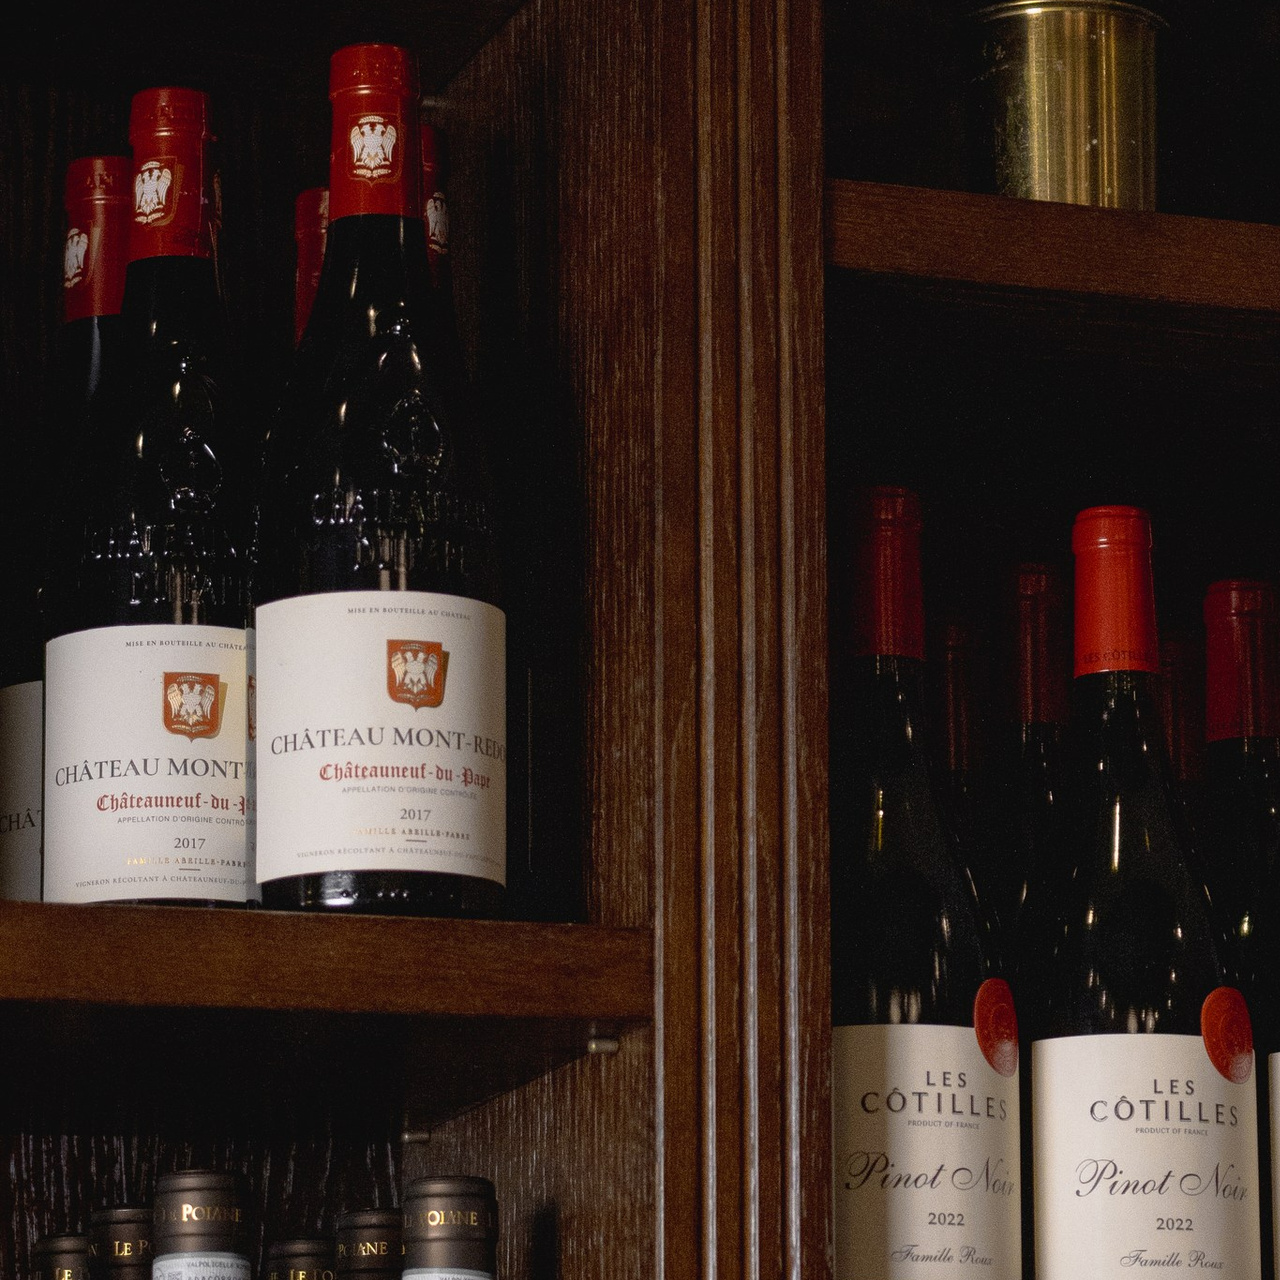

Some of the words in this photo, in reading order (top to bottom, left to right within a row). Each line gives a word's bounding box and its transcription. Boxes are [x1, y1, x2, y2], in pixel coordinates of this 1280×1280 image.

[382, 607, 426, 615] BOUTEILLE
[125, 640, 144, 648] MISE
[159, 640, 203, 648] BOUTEILLE
[270, 727, 385, 755] CHÂTEAU
[55, 757, 159, 787] CHÂTEAU
[341, 785, 396, 794] APPELLATION
[117, 815, 170, 824] APPELLATION
[172, 815, 213, 824] D'ORIGINE
[399, 807, 432, 821] 2017
[173, 837, 206, 850] 2017
[75, 877, 110, 888] VIGNERON
[112, 874, 159, 885] RÉCOLTANT
[926, 1071, 967, 1088] LES
[1153, 1079, 1195, 1095] LES
[860, 1087, 1008, 1121] CÔTILLES
[1089, 1095, 1239, 1127] CÔTILLES
[956, 1121, 980, 1130] FRANCE
[1184, 1128, 1208, 1136] FRANCE
[845, 1151, 949, 1190] Pinot
[951, 1156, 1015, 1196] Noir
[1075, 1158, 1175, 1198] Pinot
[1179, 1161, 1248, 1201] Noir
[928, 1212, 965, 1227] 2022
[1156, 1217, 1194, 1231] 2022
[890, 1244, 954, 1263] Famille
[1119, 1249, 1183, 1267] Famille
